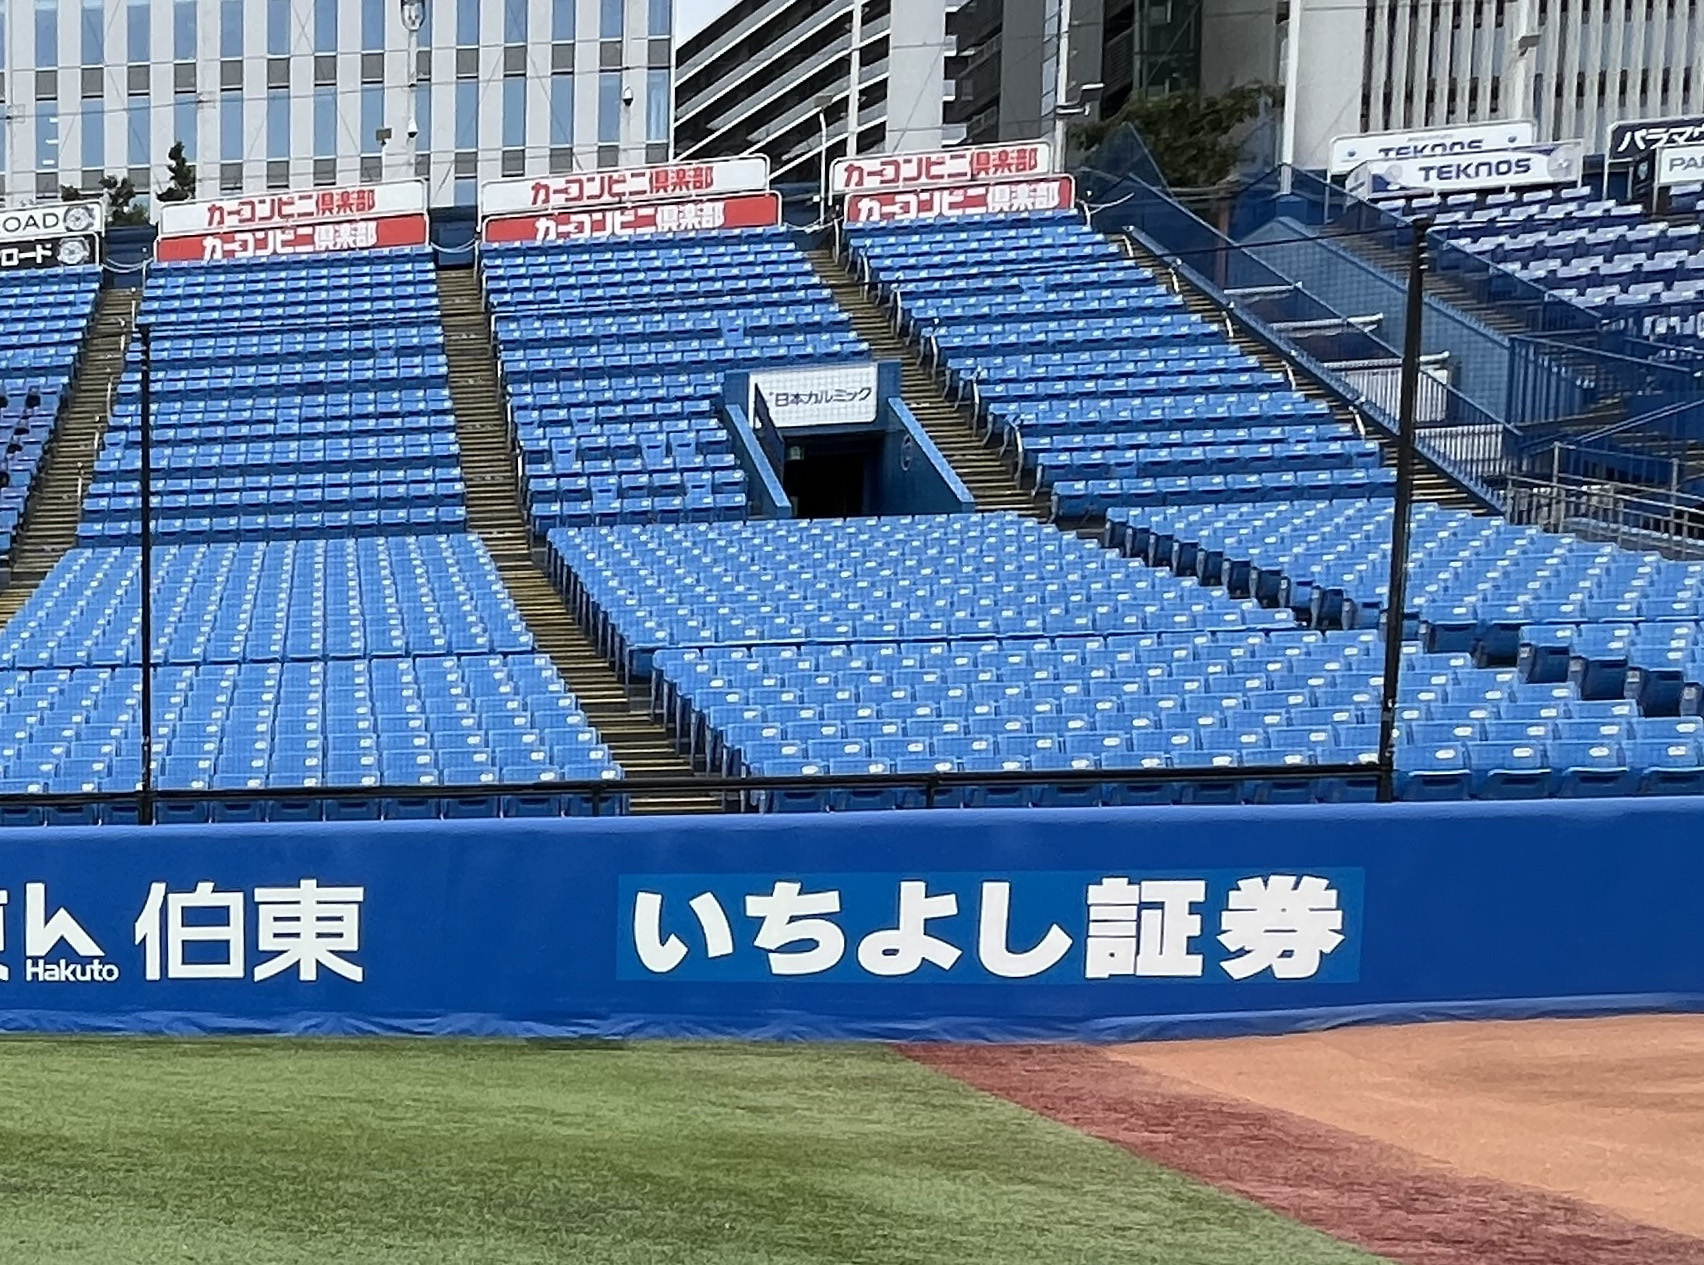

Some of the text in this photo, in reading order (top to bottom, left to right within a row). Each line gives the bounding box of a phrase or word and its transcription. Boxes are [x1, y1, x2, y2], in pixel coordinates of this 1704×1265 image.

[844, 147, 1039, 188] カーコンビニ倶楽部
[1418, 157, 1532, 182] TEKNOS
[1669, 155, 1704, 172] PA
[531, 165, 714, 206] カーコンビニ倶楽部
[857, 181, 1061, 222] カーコンビニ倶楽部
[207, 189, 376, 227] カーコンビニ倶楽部
[534, 200, 726, 241] カーコンビニ倶楽部
[1, 243, 53, 267] ロード
[202, 220, 377, 263] カーコンビニ倶楽部
[775, 386, 872, 407] 日本カルミック
[134, 878, 365, 982] 伯東
[633, 874, 1345, 981] いちよし証券
[25, 958, 119, 982] Hakuto
